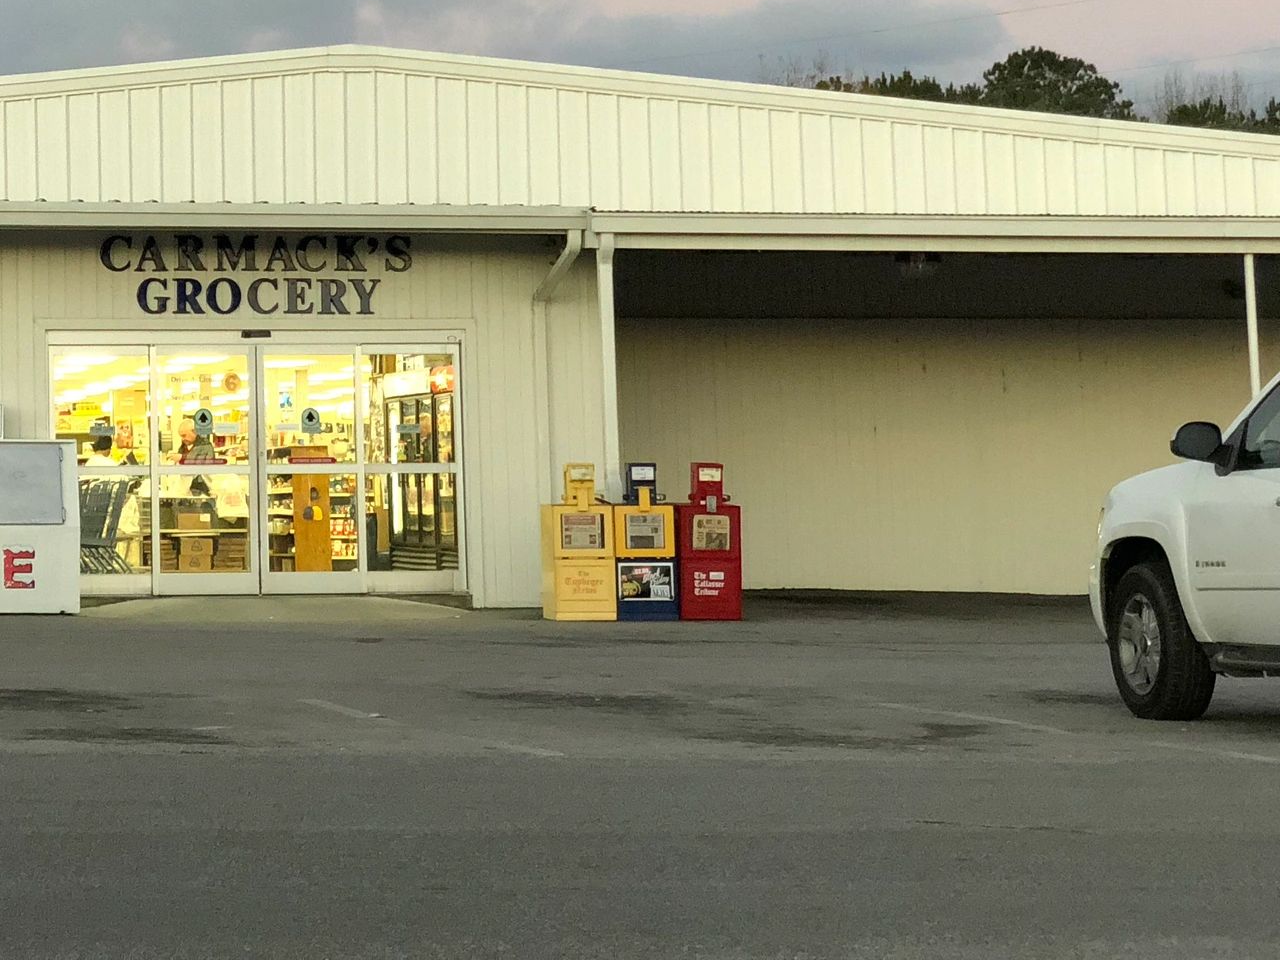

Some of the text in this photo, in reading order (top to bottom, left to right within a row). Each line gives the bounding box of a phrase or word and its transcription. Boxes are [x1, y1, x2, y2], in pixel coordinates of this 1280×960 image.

[99, 234, 413, 272] CARMACK'S
[136, 277, 381, 315] GROCERY
[694, 571, 707, 579] The
